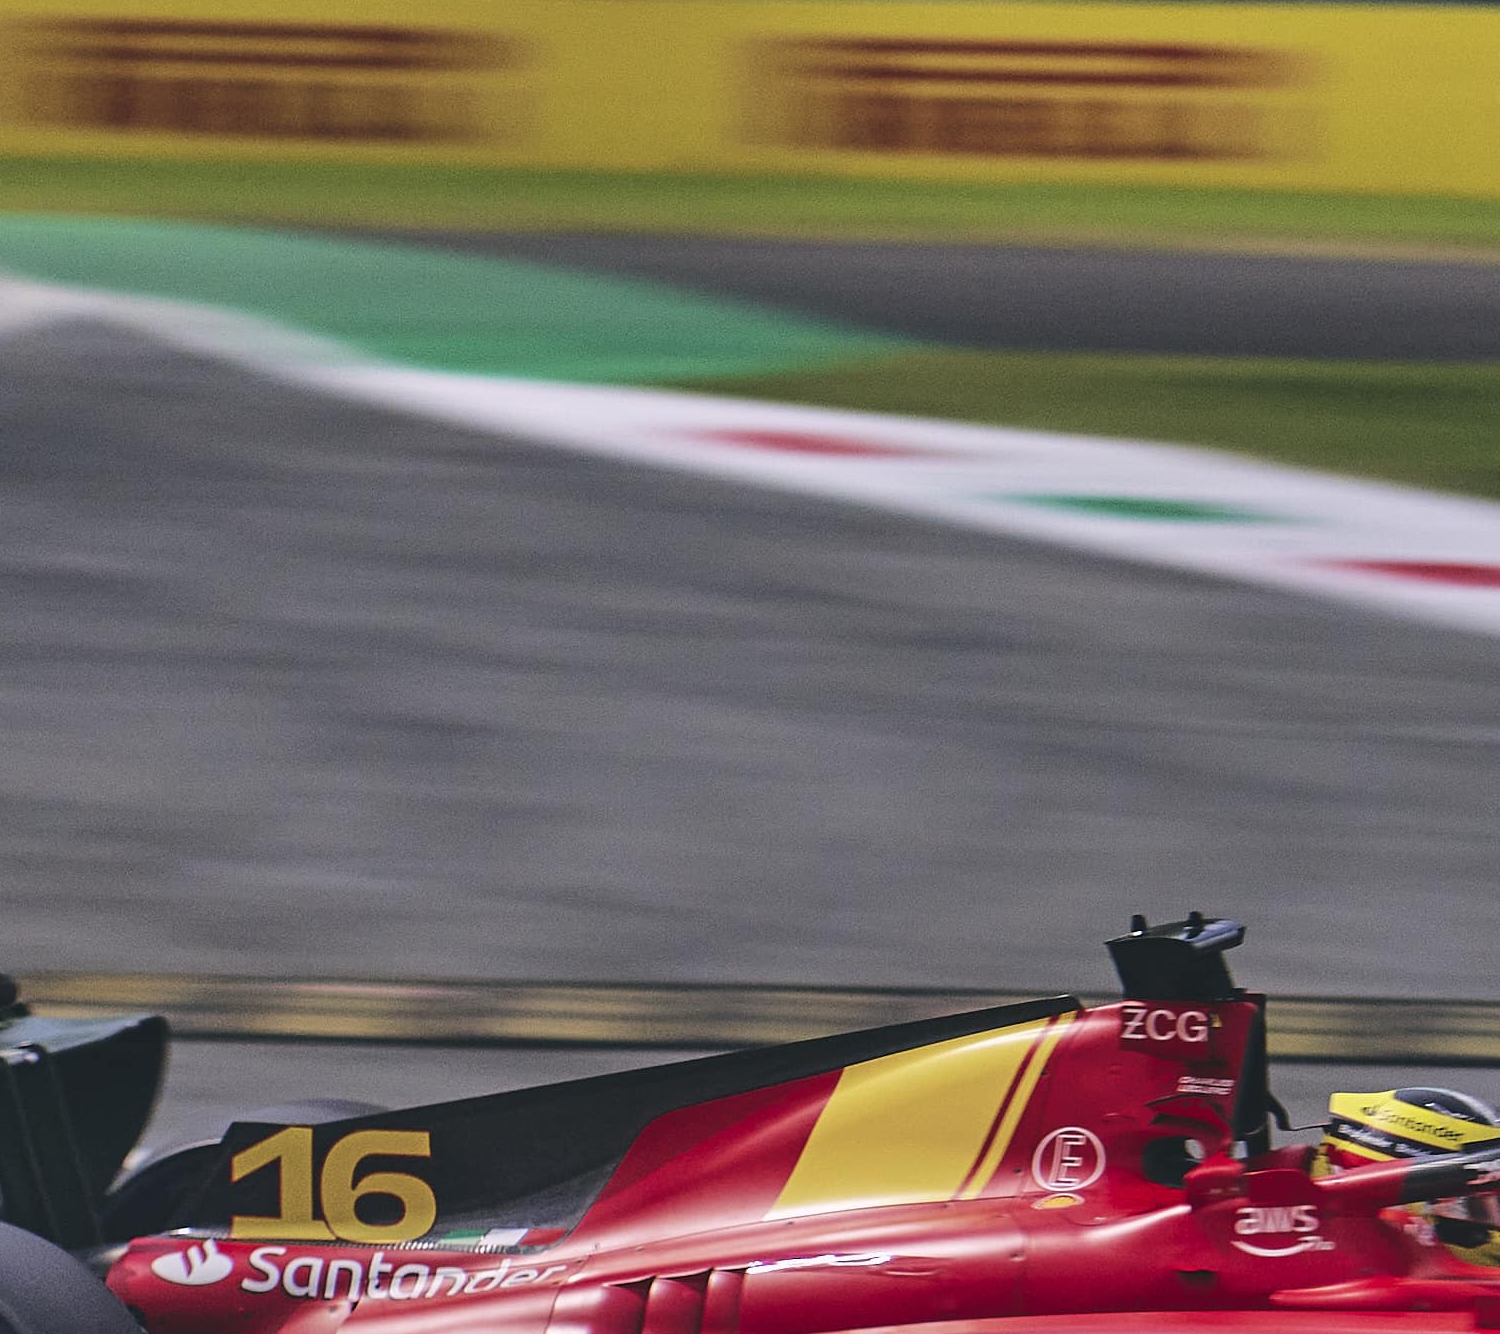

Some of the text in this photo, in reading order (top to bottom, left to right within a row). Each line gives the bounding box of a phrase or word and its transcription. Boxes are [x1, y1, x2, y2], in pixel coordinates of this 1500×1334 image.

[230, 1125, 437, 1245] 16
[1234, 1205, 1321, 1236] aws
[240, 1246, 569, 1301] Santander
